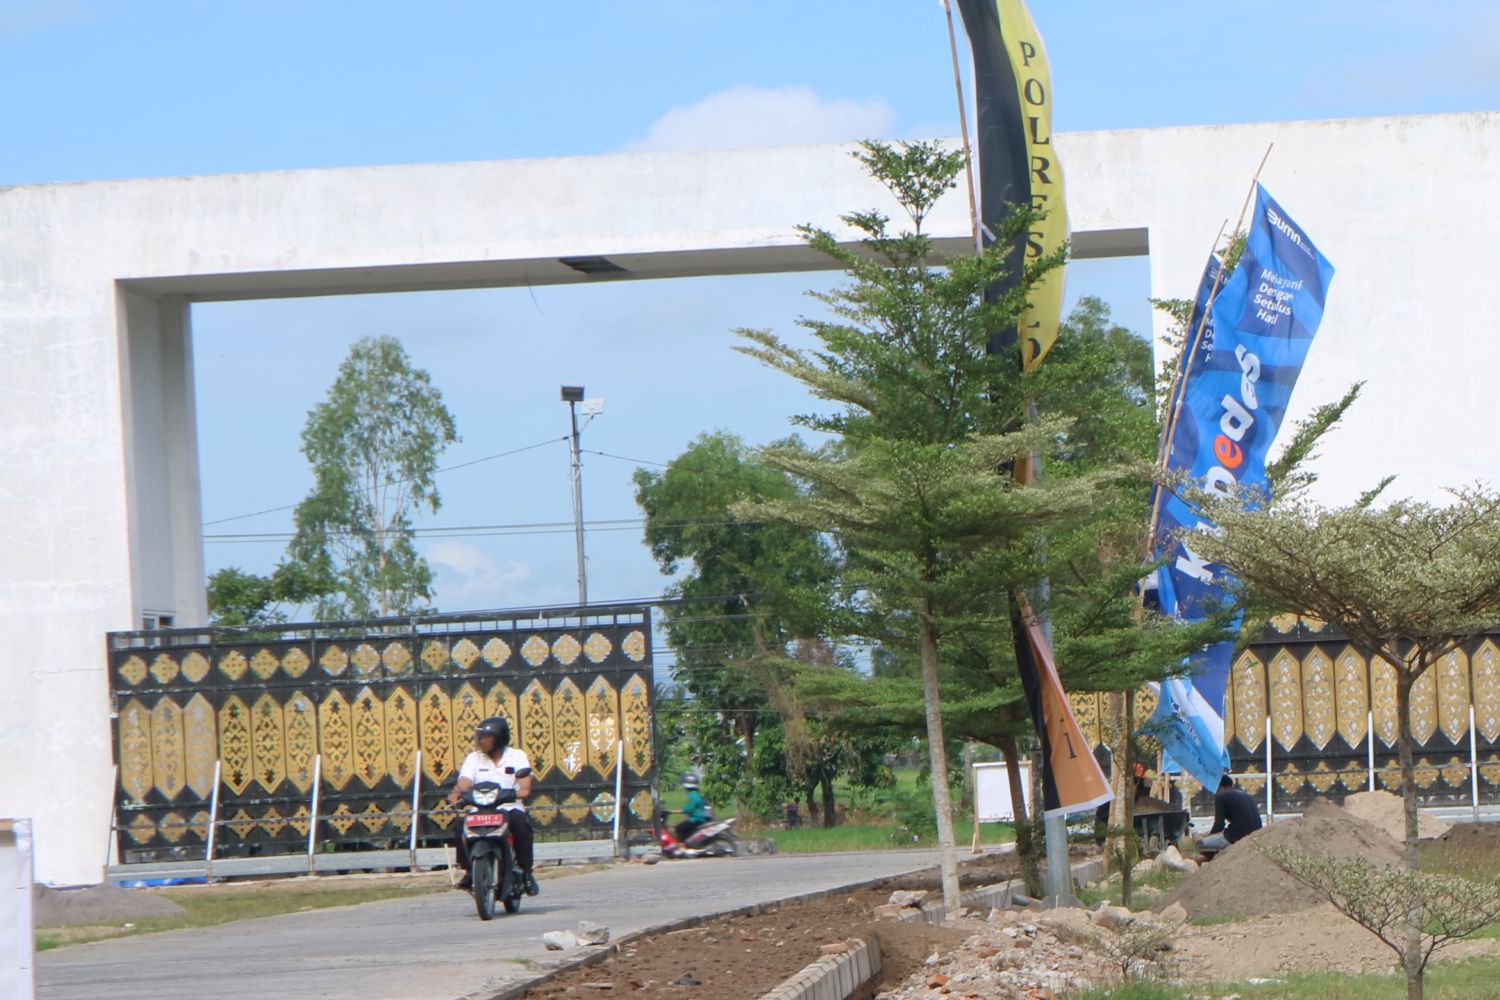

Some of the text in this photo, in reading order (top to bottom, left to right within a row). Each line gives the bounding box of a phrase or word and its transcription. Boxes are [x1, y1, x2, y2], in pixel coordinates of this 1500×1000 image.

[1260, 268, 1303, 291] Melayani
[1253, 294, 1292, 316] Setulus
[1256, 308, 1279, 325] Hati
[1175, 343, 1261, 582] Kpedes
